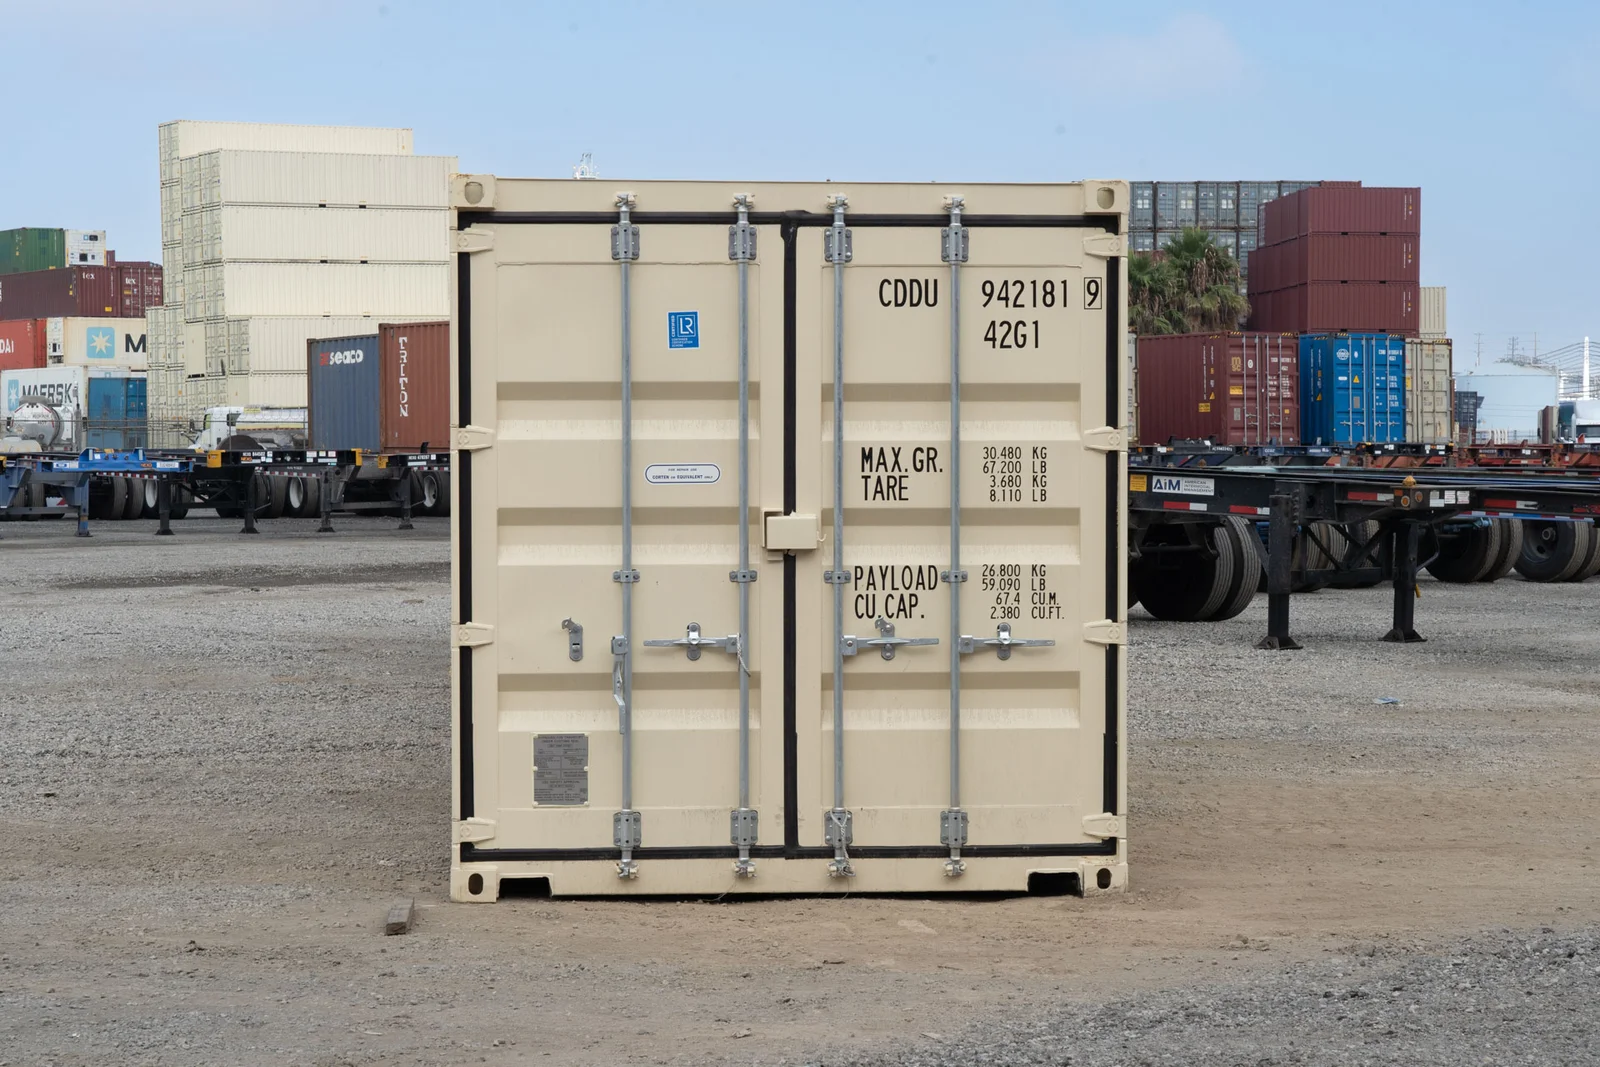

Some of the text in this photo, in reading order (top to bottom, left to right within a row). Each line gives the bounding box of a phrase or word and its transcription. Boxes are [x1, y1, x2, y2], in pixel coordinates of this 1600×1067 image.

[879, 279, 1099, 308] CDDU 942181 9
[679, 317, 694, 335] LR
[984, 320, 1039, 349] 42G1
[329, 348, 364, 366] seaco
[398, 336, 409, 417] TRITON
[860, 446, 1047, 473] MAX.GR. 30.480 KG
[982, 460, 1047, 474] 67.200 LB
[861, 475, 1047, 501] TARE 3.680 KG
[989, 489, 1047, 502] 8.110 LB
[854, 564, 1047, 591] PAYLOAD 26.800 KG
[981, 578, 1046, 591] 59.090 LB
[854, 592, 1060, 620] CU.CAP. 67.4 CU.M.
[990, 606, 1065, 620] 2.380 CU.FT.
